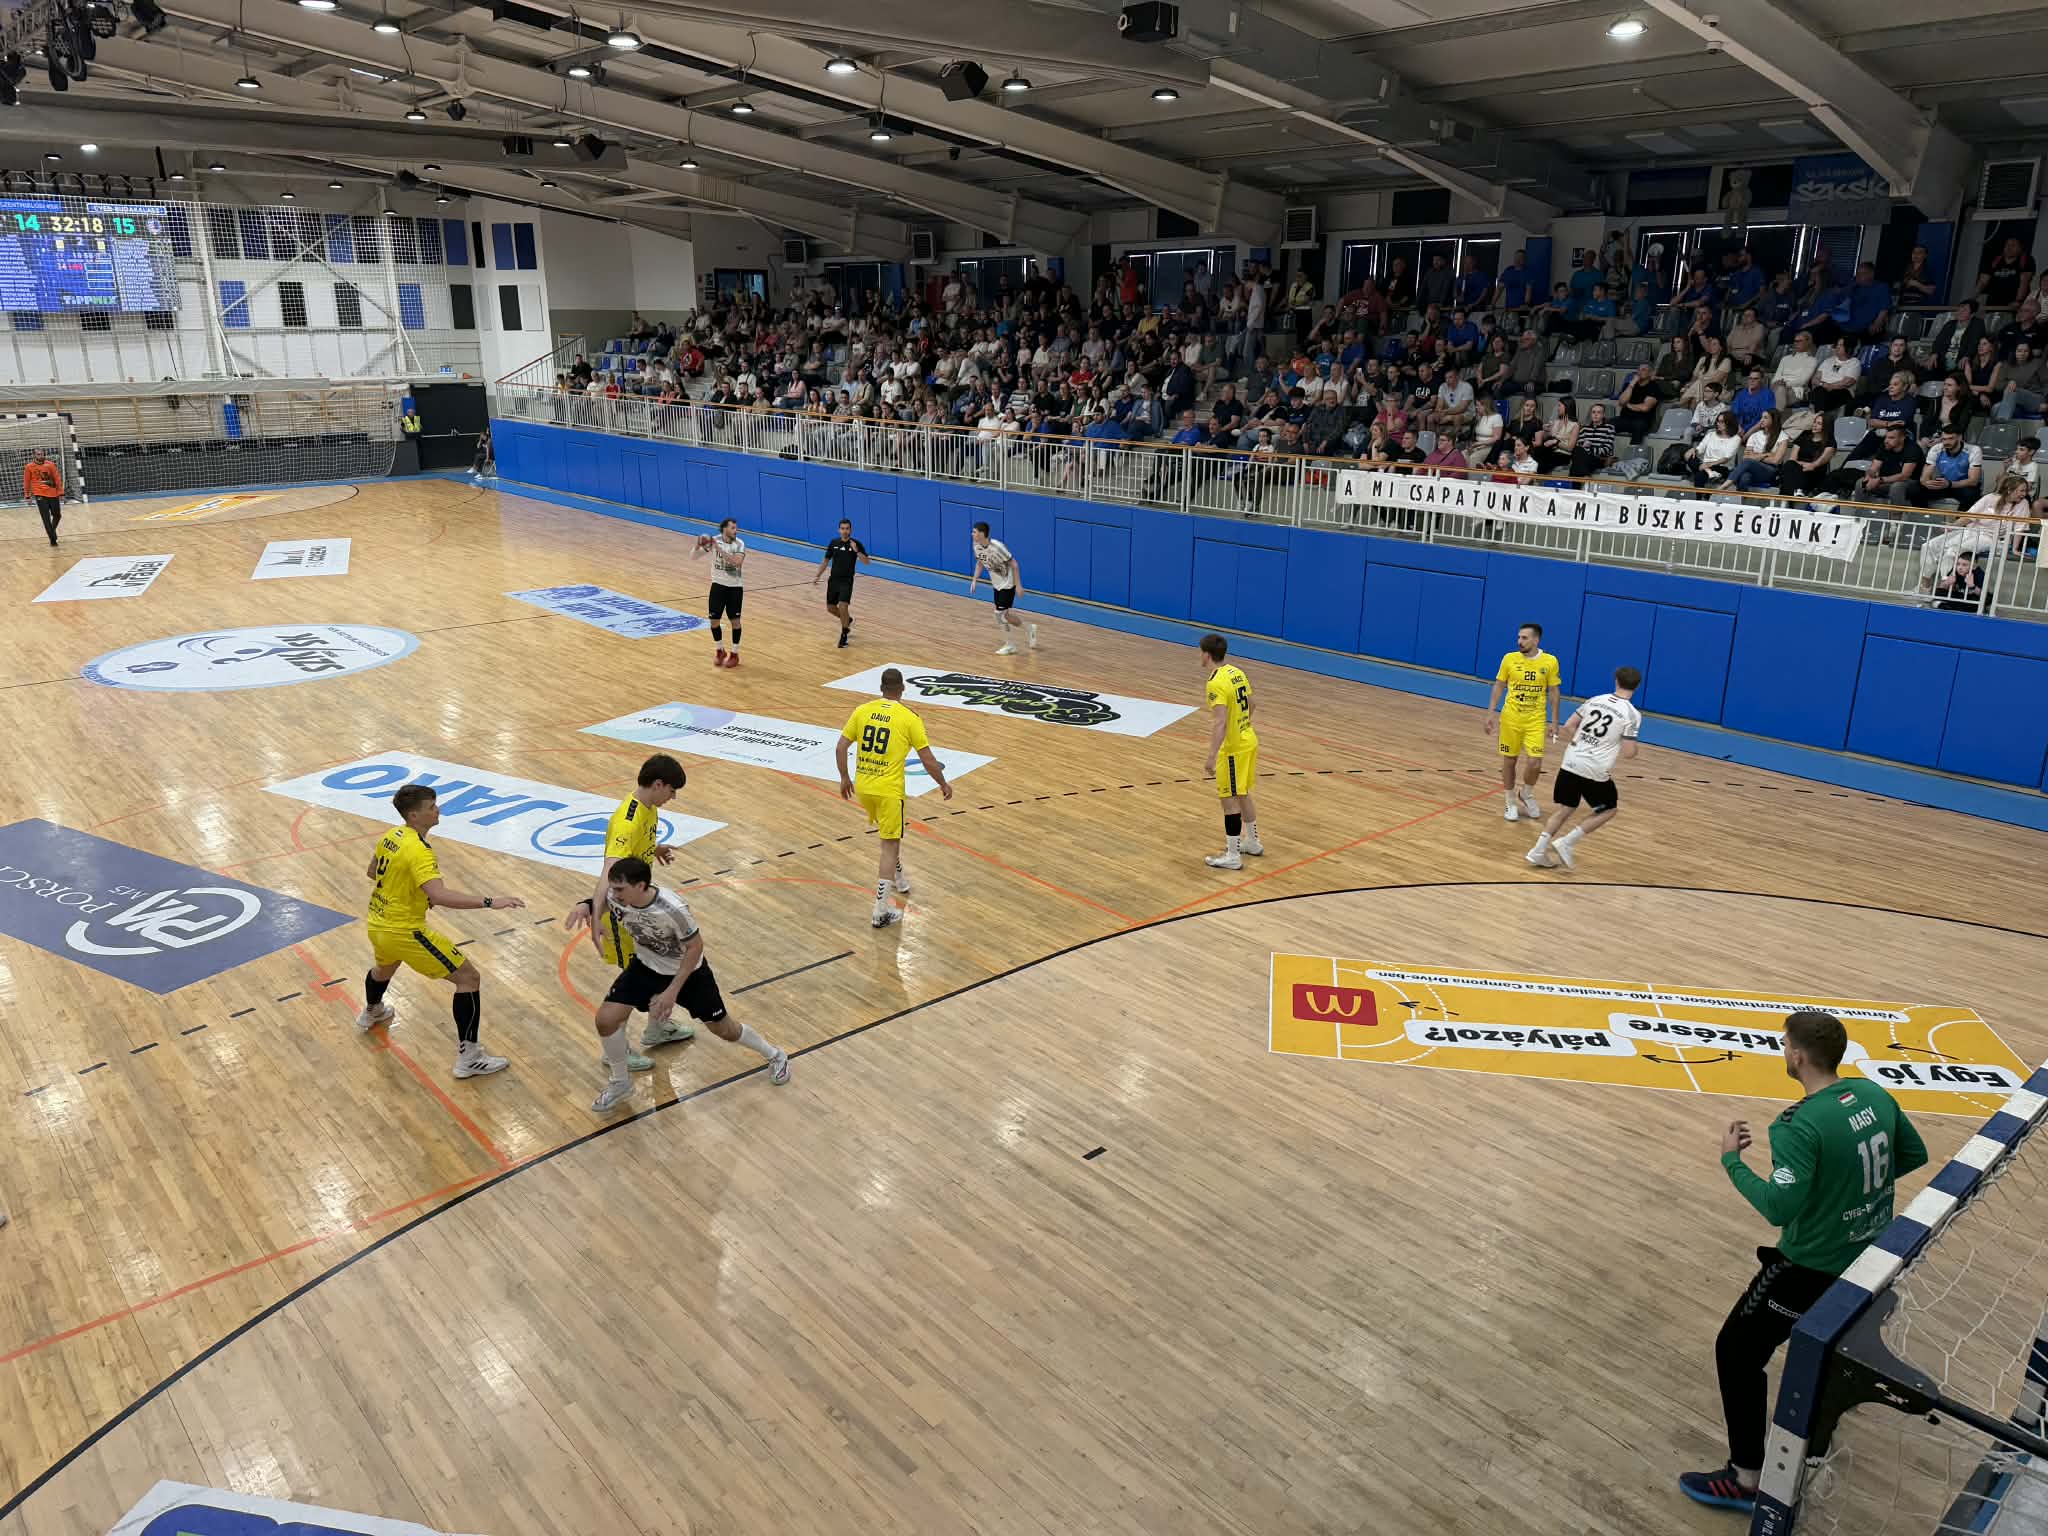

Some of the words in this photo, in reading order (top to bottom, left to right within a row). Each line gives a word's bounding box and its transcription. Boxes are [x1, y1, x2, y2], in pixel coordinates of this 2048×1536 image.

[15, 214, 40, 231] 14
[50, 216, 104, 233] 32:18
[112, 217, 137, 234] 15
[1343, 483, 1354, 498] A
[1371, 483, 1394, 499] MI
[1409, 484, 1530, 515] CSAPATUNK
[1546, 500, 1558, 517] A
[1574, 501, 1601, 523] MI
[1618, 505, 1842, 546] BÜSZKESÉGÜNK!
[1582, 710, 1613, 738] 23
[861, 725, 890, 755] 99
[1375, 971, 1450, 985] Drive-ban.
[1452, 977, 1523, 990] Campona
[1557, 986, 1611, 997] mellett
[1841, 1008, 1898, 1021] Várunk
[1426, 1025, 1614, 1052] pályázol?
[1629, 1020, 1786, 1056] kizésre
[1879, 1066, 1926, 1086] jó
[1930, 1065, 2012, 1088] Egy
[1848, 1106, 1878, 1132] NAGY
[1857, 1131, 1890, 1195] 16
